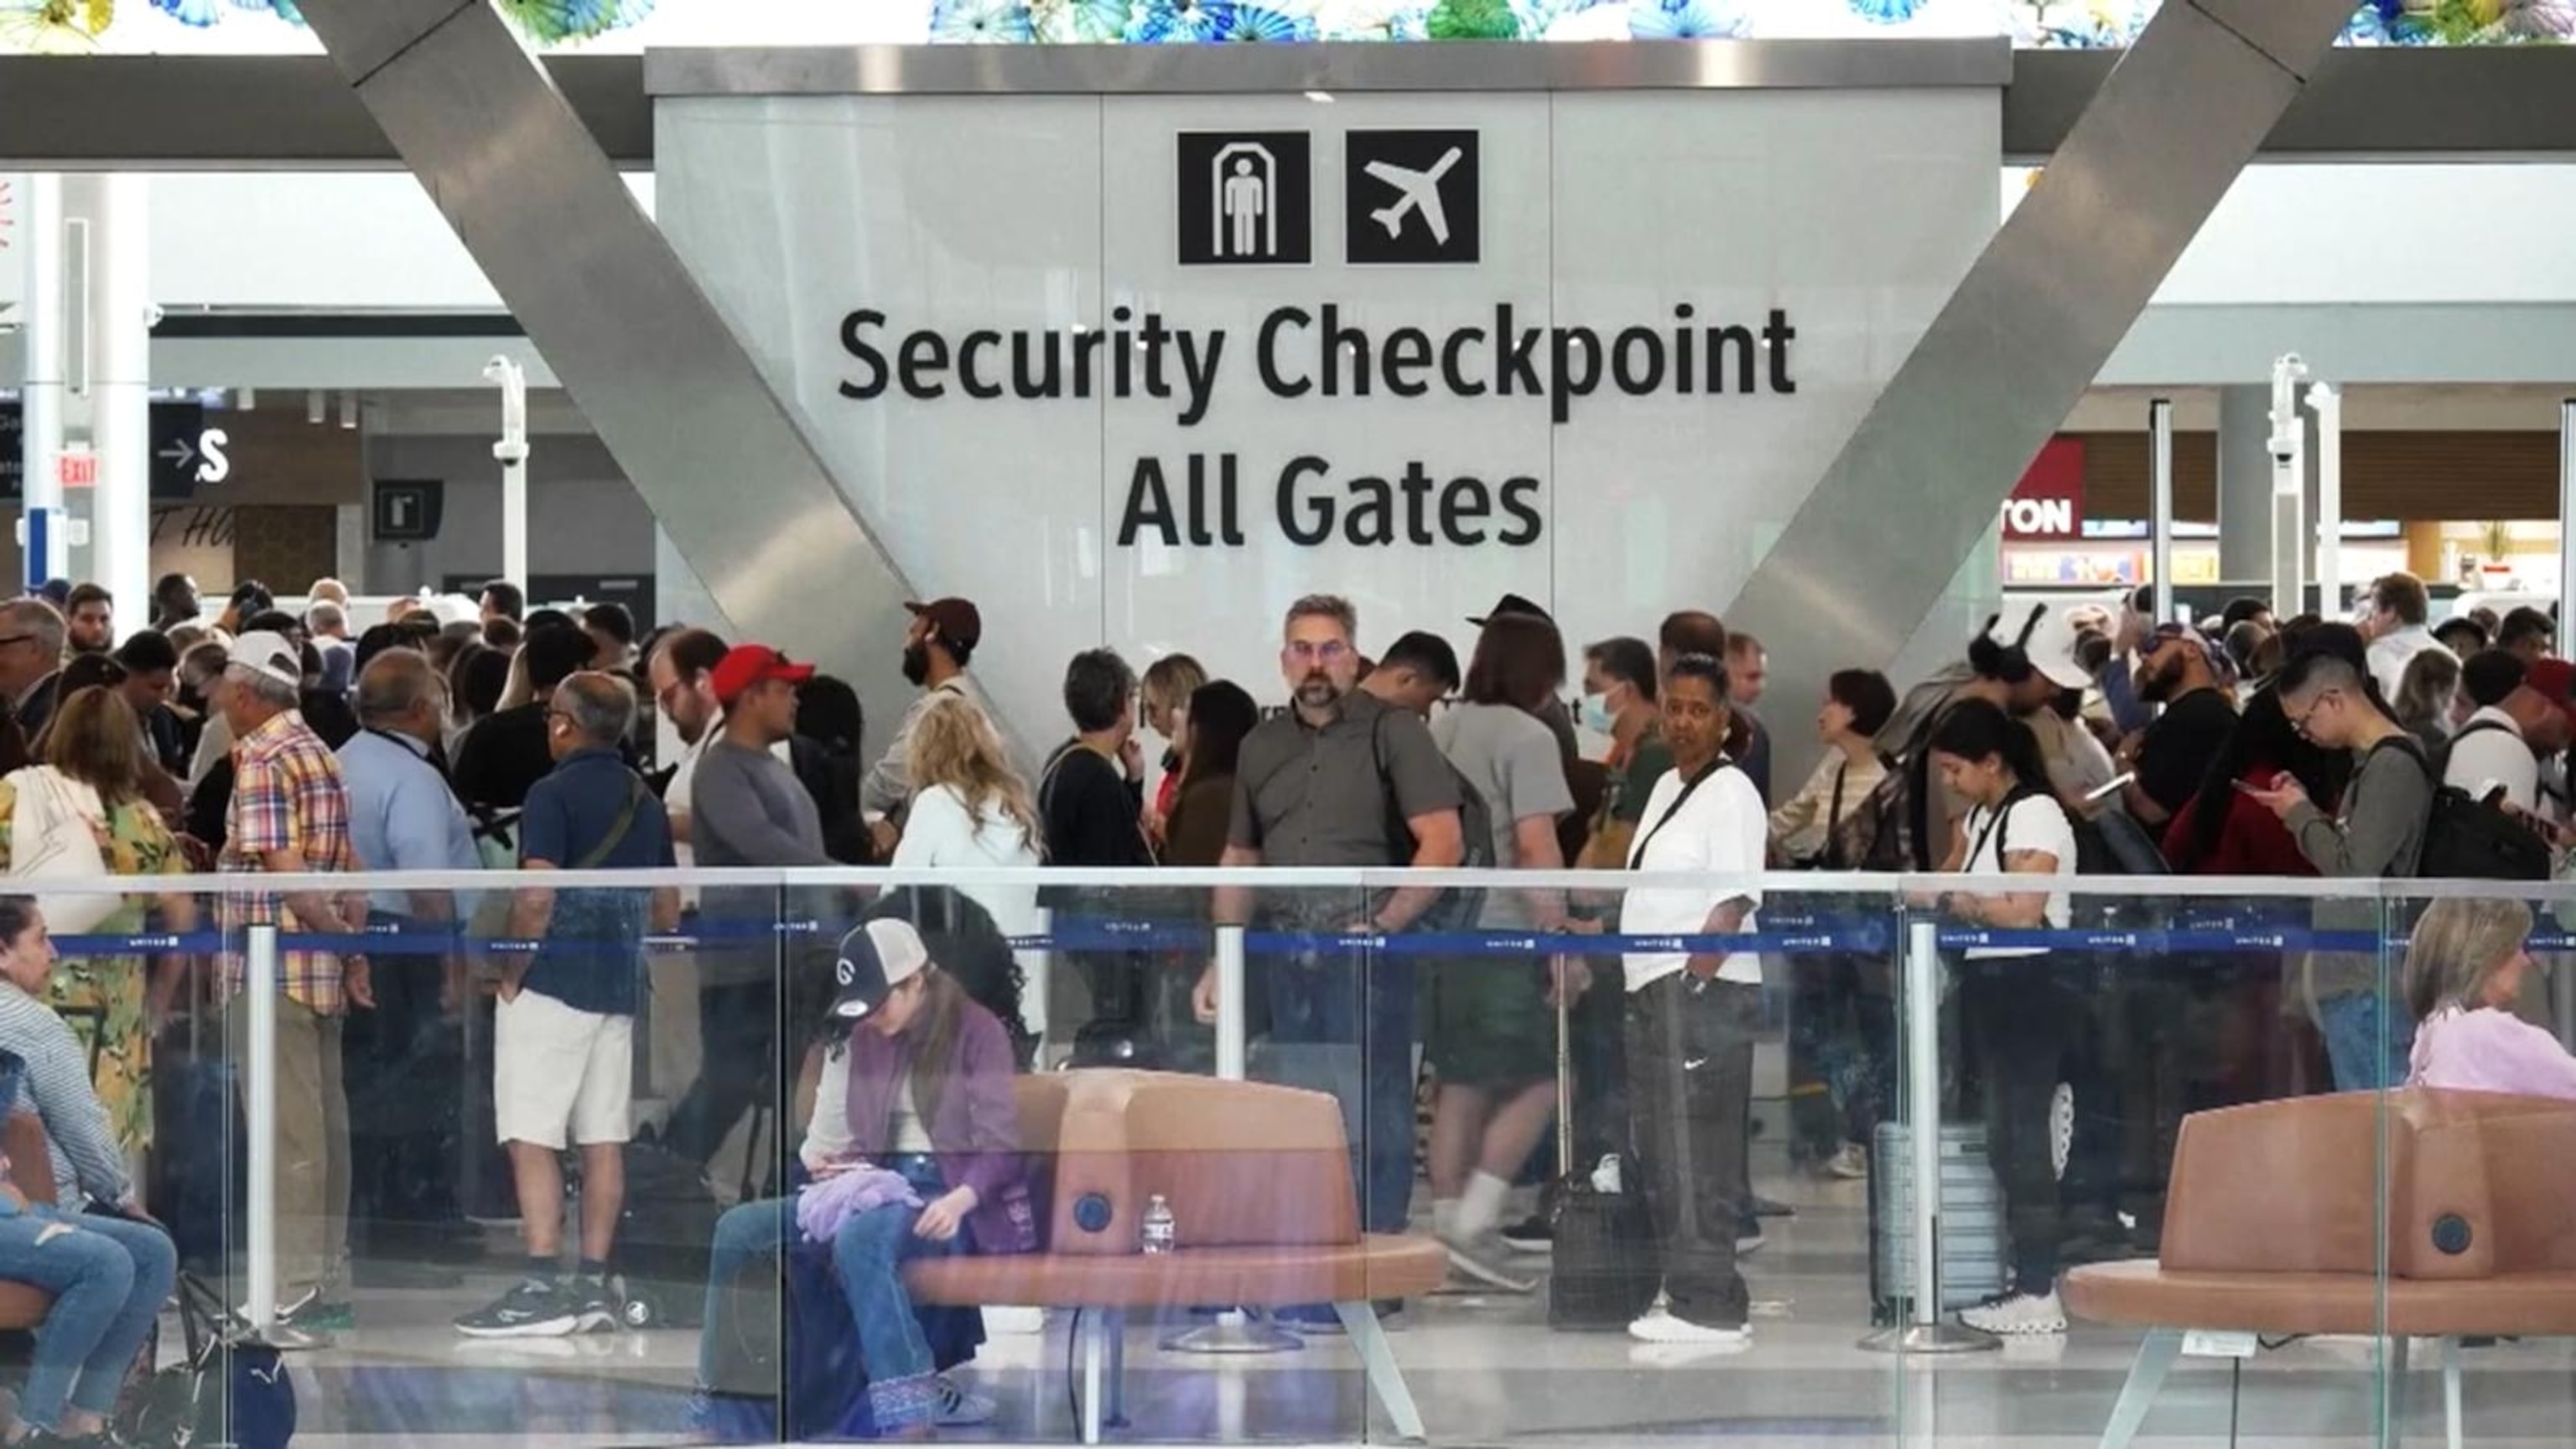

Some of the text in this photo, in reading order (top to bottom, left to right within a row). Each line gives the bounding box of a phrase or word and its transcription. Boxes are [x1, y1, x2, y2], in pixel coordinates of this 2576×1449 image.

[839, 304, 1795, 426] Security Checkpoint
[61, 457, 96, 484] EXIT
[1118, 454, 1542, 546] All Gates
